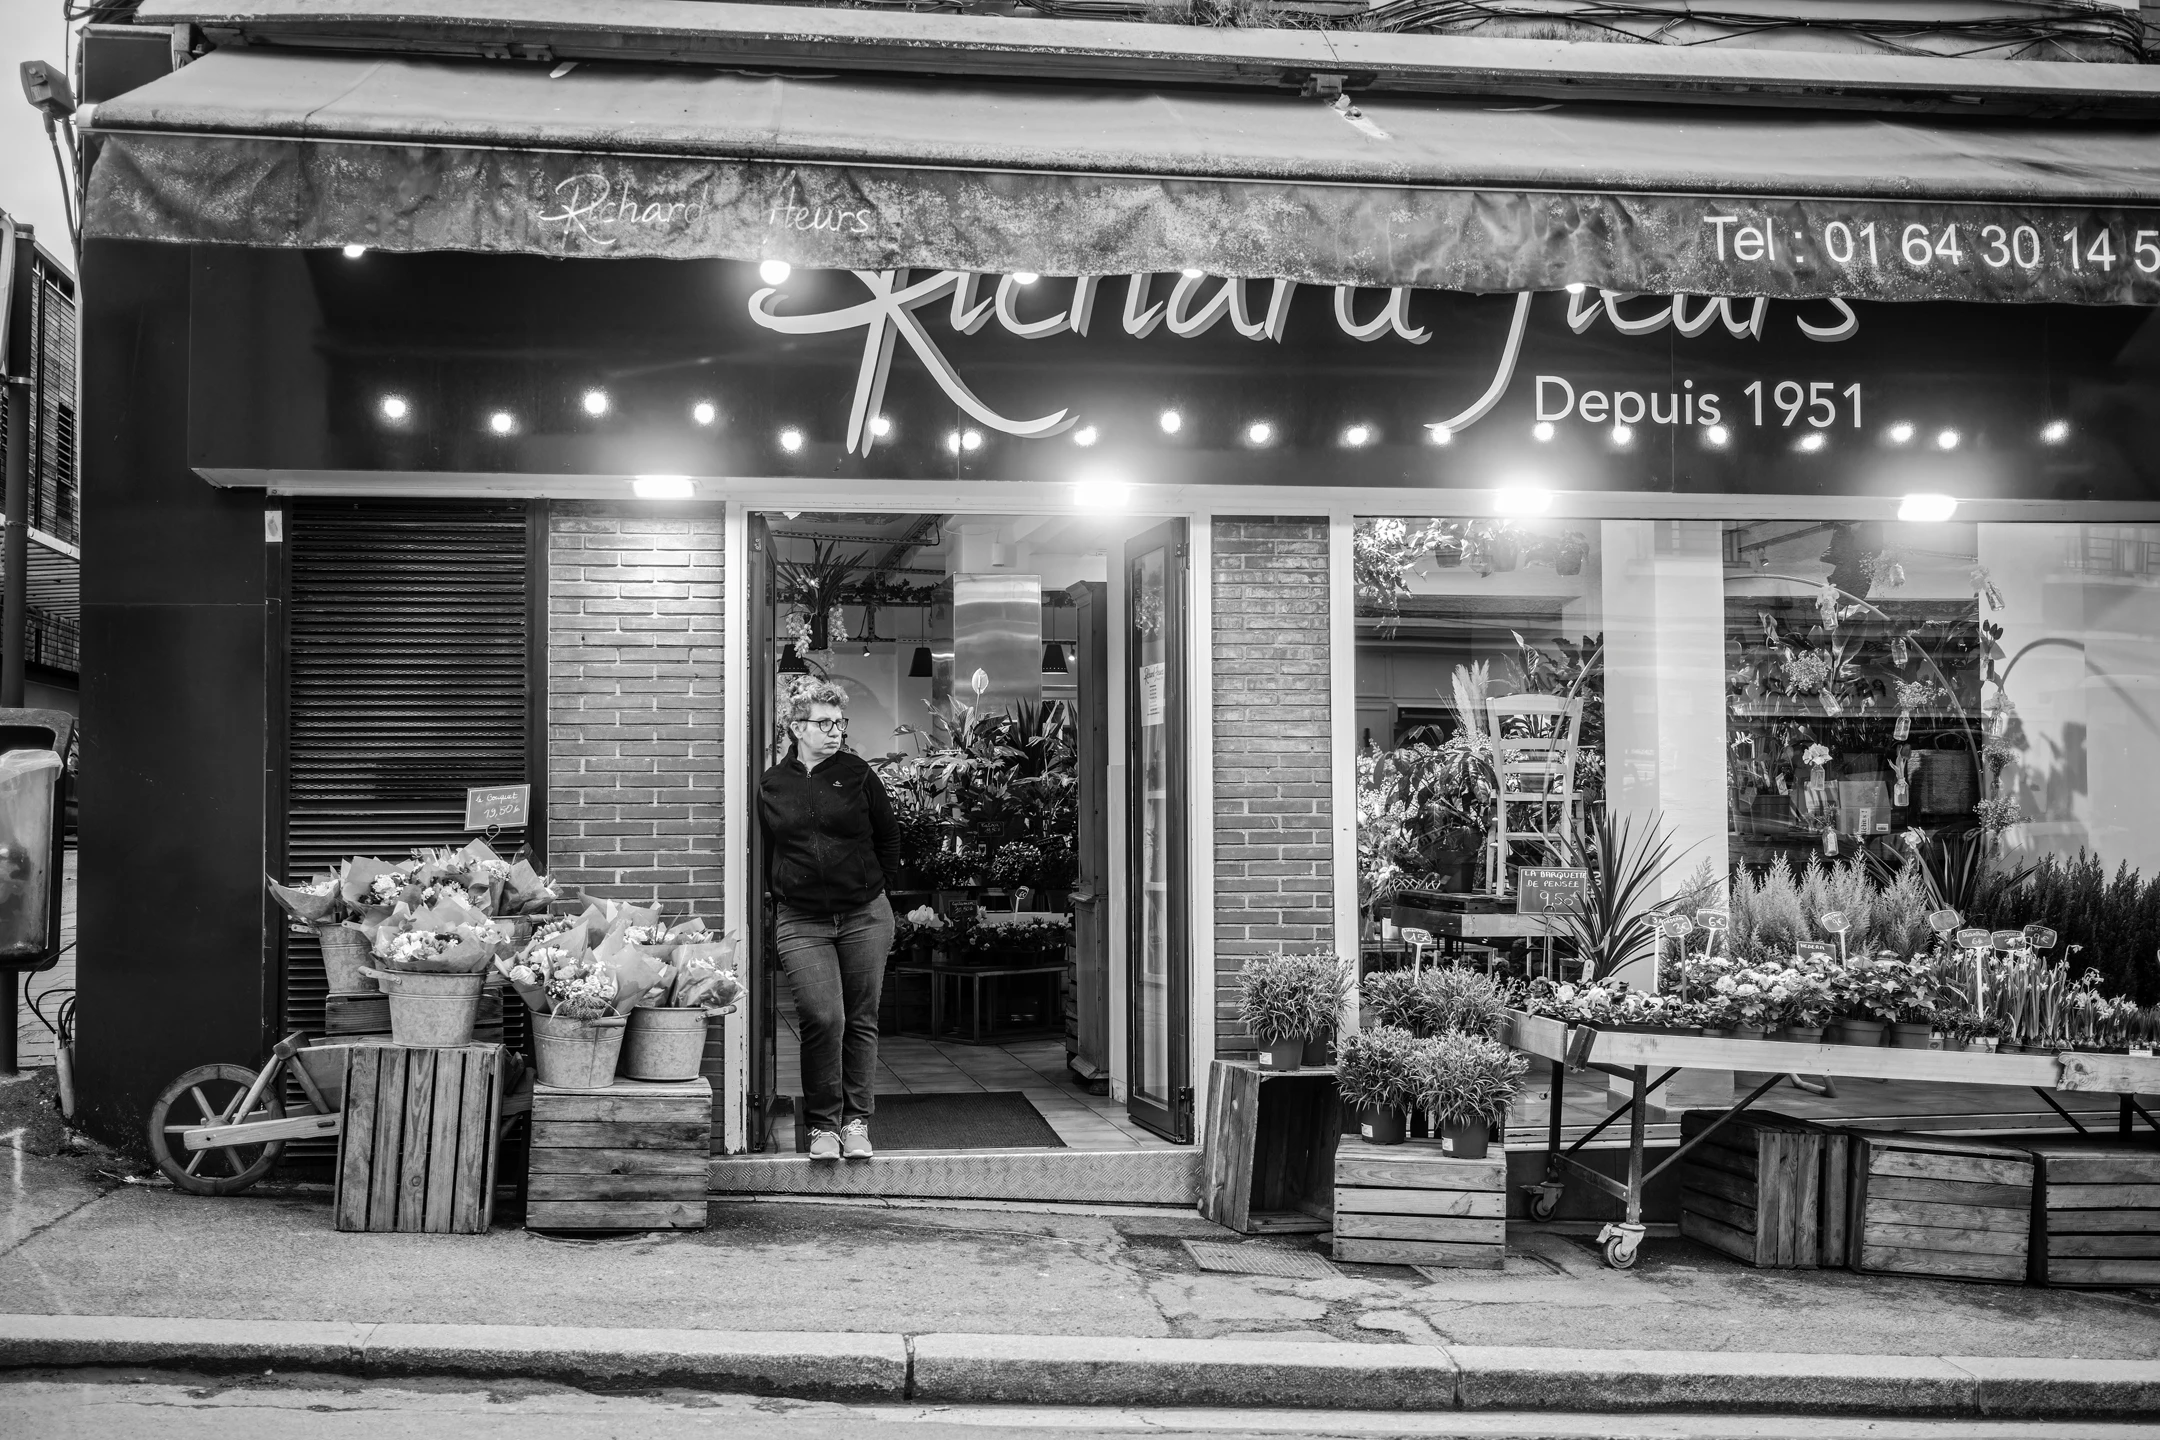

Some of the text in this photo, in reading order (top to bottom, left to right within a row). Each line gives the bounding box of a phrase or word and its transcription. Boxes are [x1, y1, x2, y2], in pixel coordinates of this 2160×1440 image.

[538, 172, 709, 249] Richard
[1703, 215, 1776, 261] Tel
[1824, 220, 1879, 266] 01
[1901, 222, 1963, 267] 64
[1981, 224, 2040, 269] 30
[2062, 226, 2117, 272] 14
[1535, 374, 1863, 432] Depuis 1951
[1708, 916, 1726, 927] 6€
